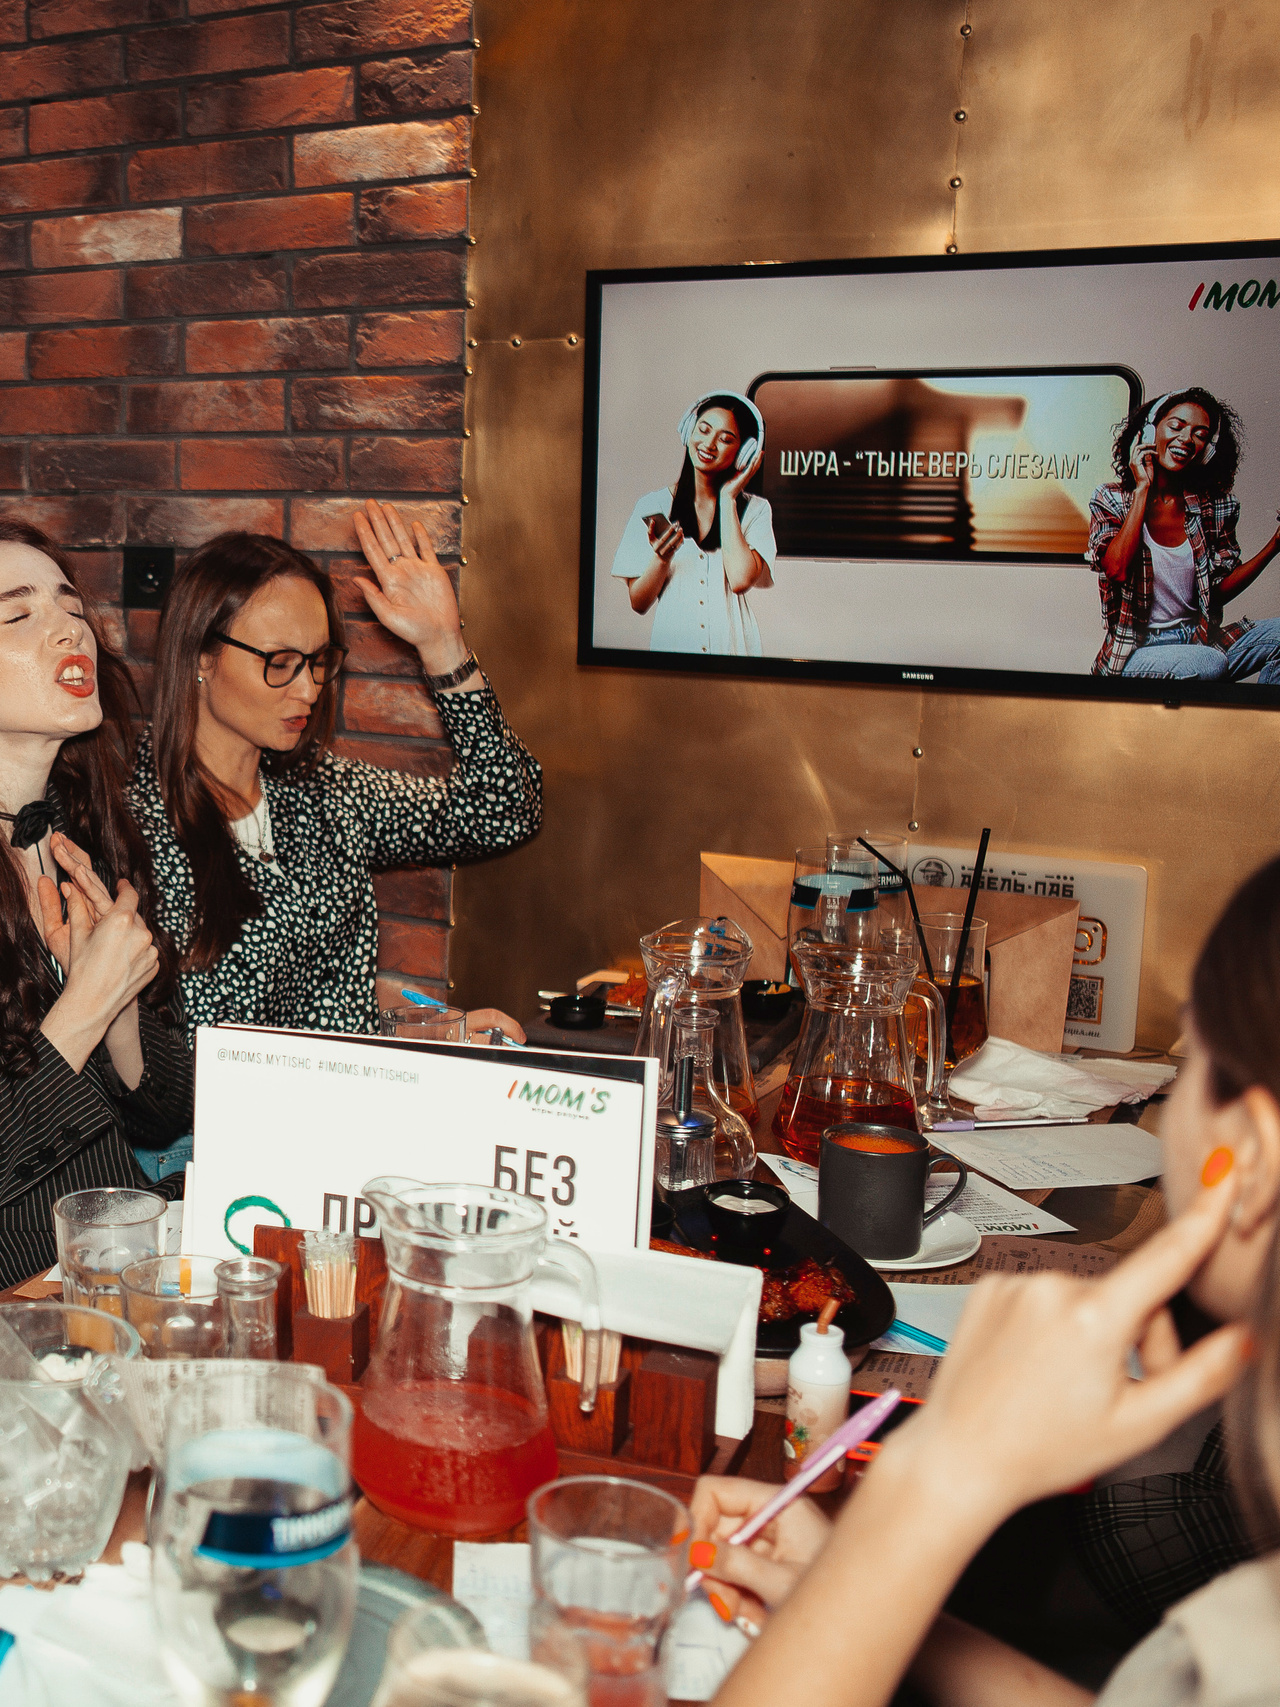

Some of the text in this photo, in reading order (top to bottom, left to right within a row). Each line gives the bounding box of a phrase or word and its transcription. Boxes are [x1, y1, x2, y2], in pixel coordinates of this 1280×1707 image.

[780, 450, 840, 477] ШУРА
[899, 450, 926, 478] НЕ
[928, 450, 983, 479] ВЕРЬ
[902, 671, 934, 680] SAMSUNG
[217, 1047, 420, 1085] @IMOMS.MYTISHC #IMOMS.MYTISHCHI
[494, 1144, 577, 1207] БЕЗ
